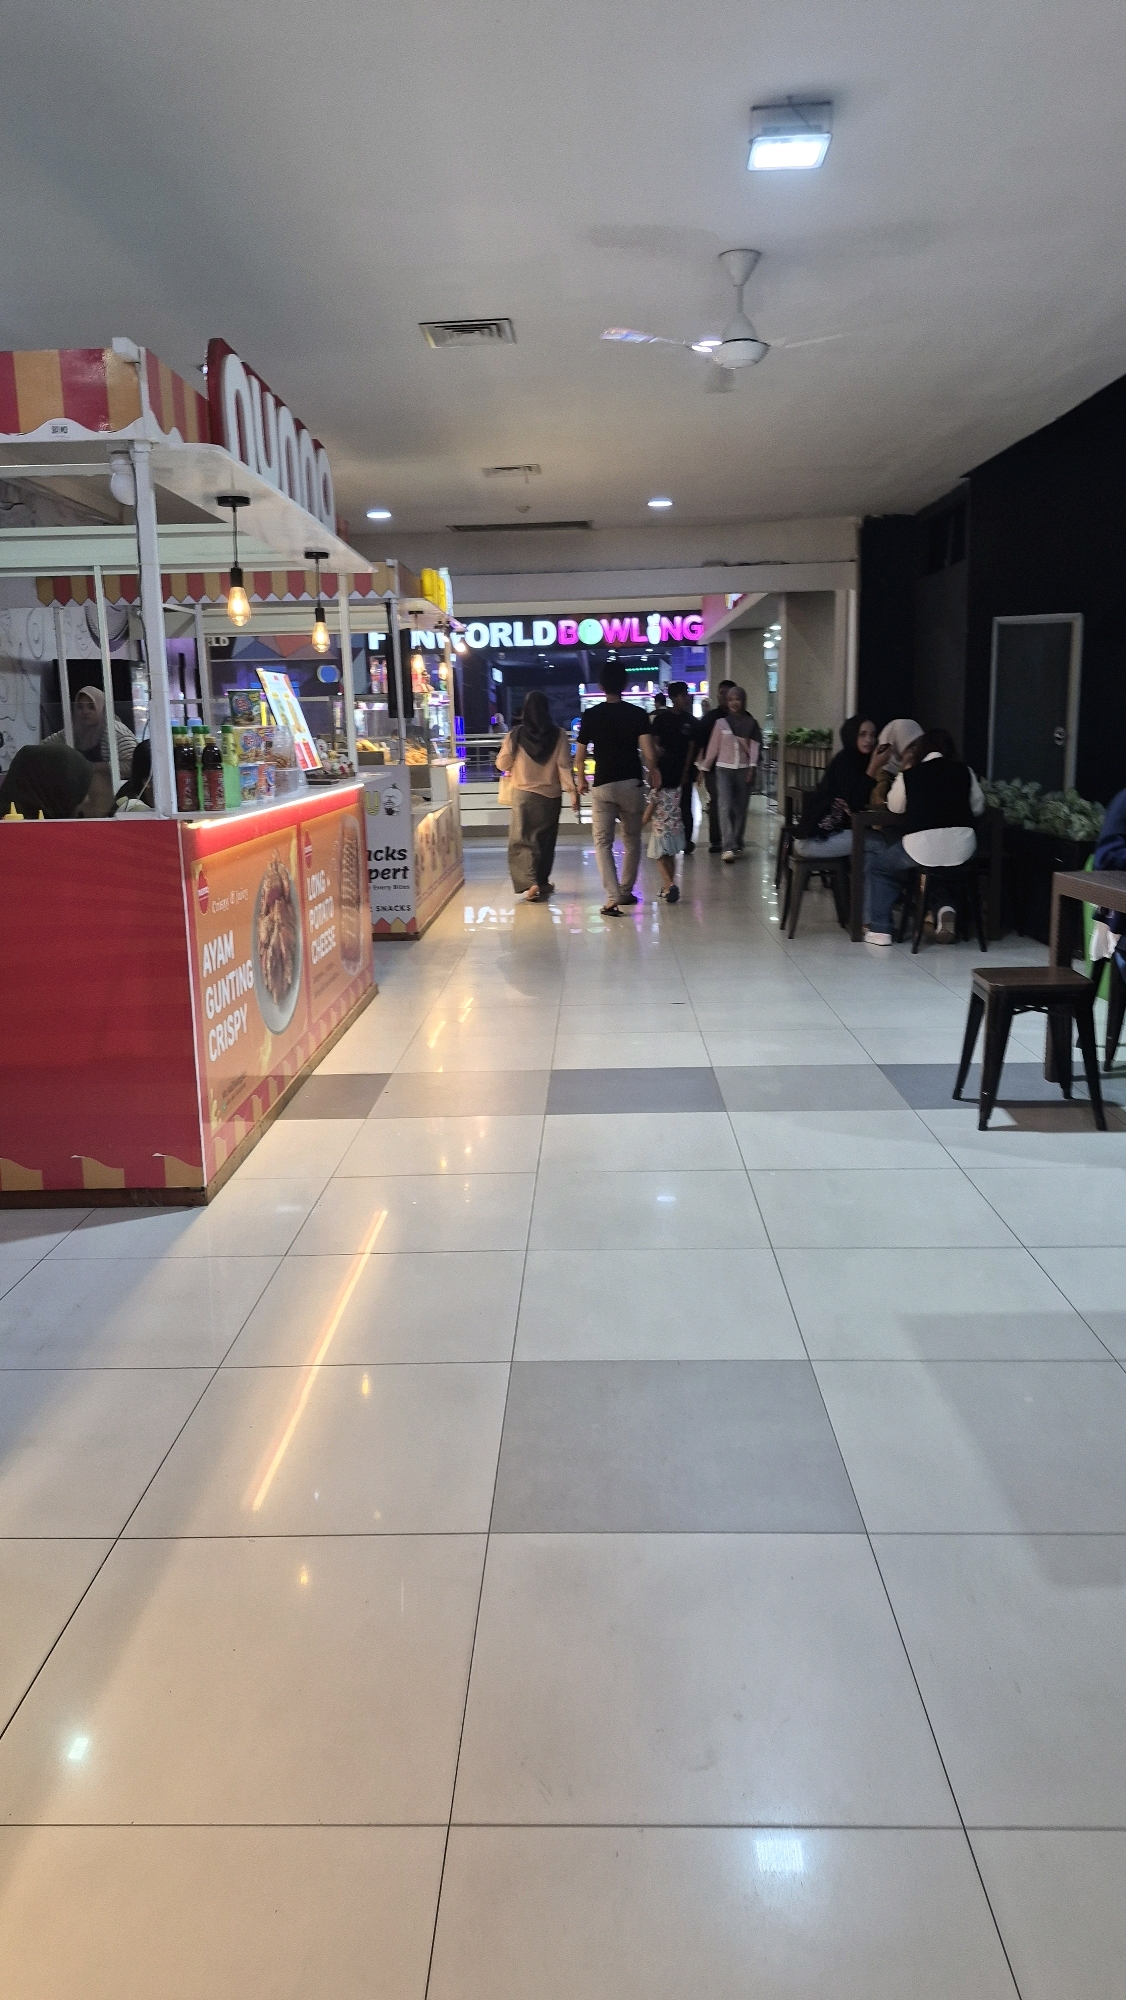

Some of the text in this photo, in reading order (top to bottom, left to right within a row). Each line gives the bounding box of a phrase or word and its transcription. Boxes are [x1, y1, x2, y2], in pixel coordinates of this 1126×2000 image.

[203, 930, 235, 977] AYAM
[205, 959, 254, 1020] GUNTING
[208, 1003, 248, 1062] CRISPY
